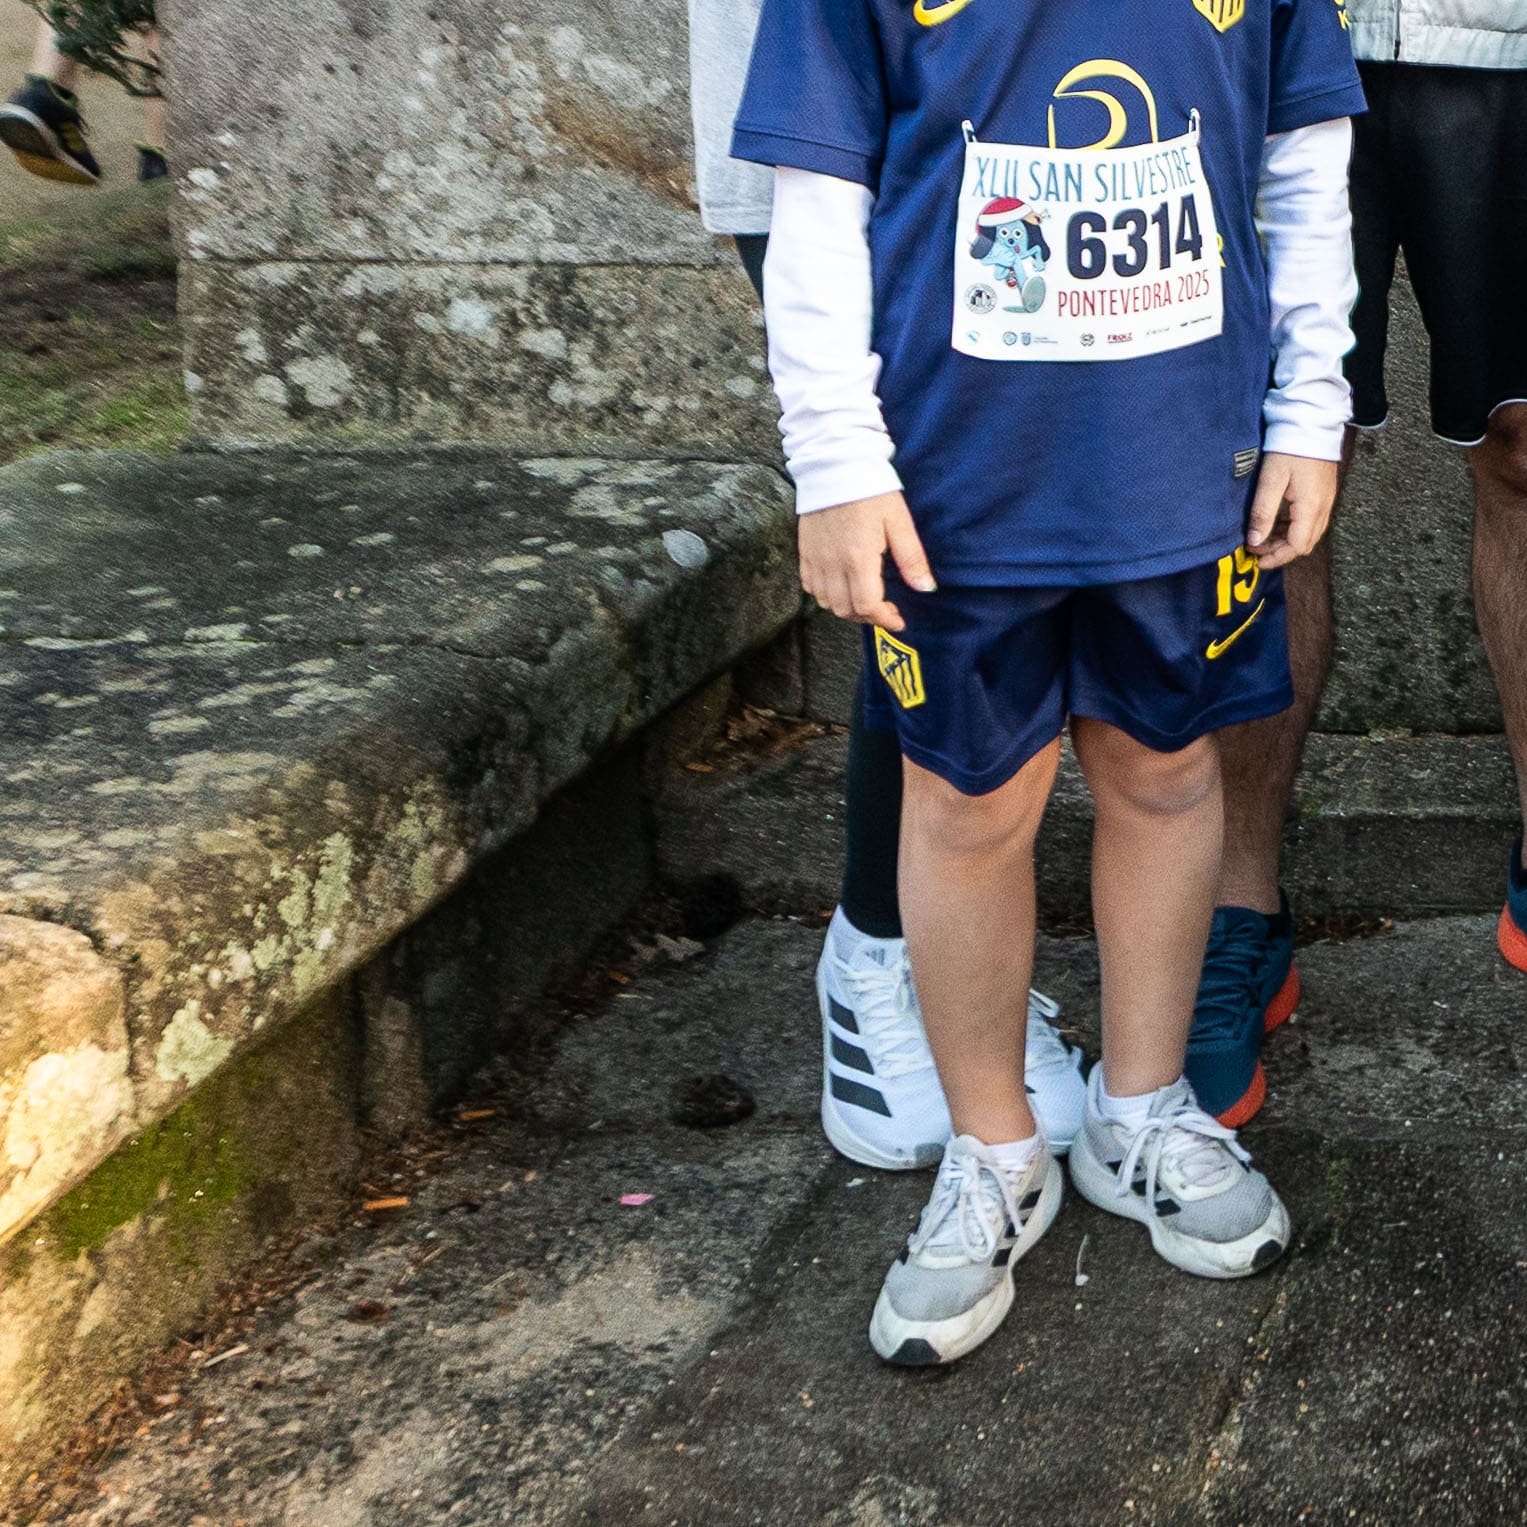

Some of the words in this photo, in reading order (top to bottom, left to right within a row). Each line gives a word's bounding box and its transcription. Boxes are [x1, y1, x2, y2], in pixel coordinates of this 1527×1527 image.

[972, 156, 1018, 198] XLII
[1028, 161, 1082, 202] SAN
[1095, 146, 1196, 202] SILVESTRE
[1066, 193, 1203, 280] 6314
[1058, 283, 1173, 318] PONTEVEDRA
[1177, 269, 1210, 304] 2025
